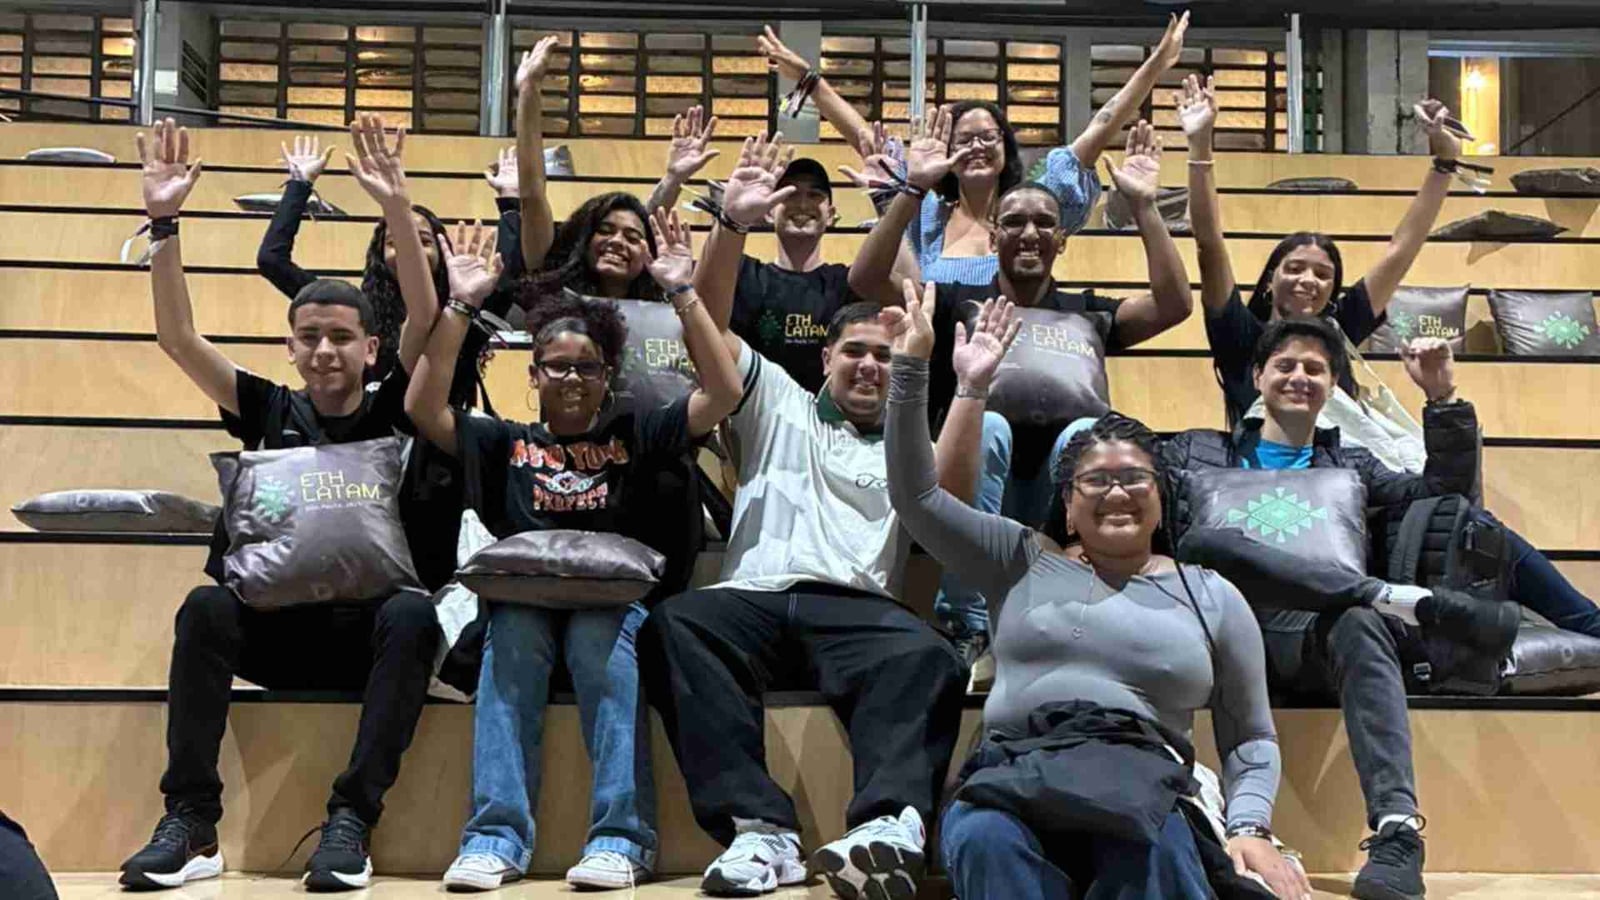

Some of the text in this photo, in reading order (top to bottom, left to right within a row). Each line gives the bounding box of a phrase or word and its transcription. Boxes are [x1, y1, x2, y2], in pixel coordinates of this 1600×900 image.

[786, 313, 812, 326] ETH
[1418, 314, 1442, 328] ETH
[1031, 323, 1067, 341] ETH
[1419, 325, 1460, 337] LATAM
[645, 338, 680, 355] ETH
[1033, 333, 1097, 359] LATAM
[645, 351, 696, 372] LATA
[301, 469, 344, 487] ETH
[302, 483, 380, 502] LATAM
